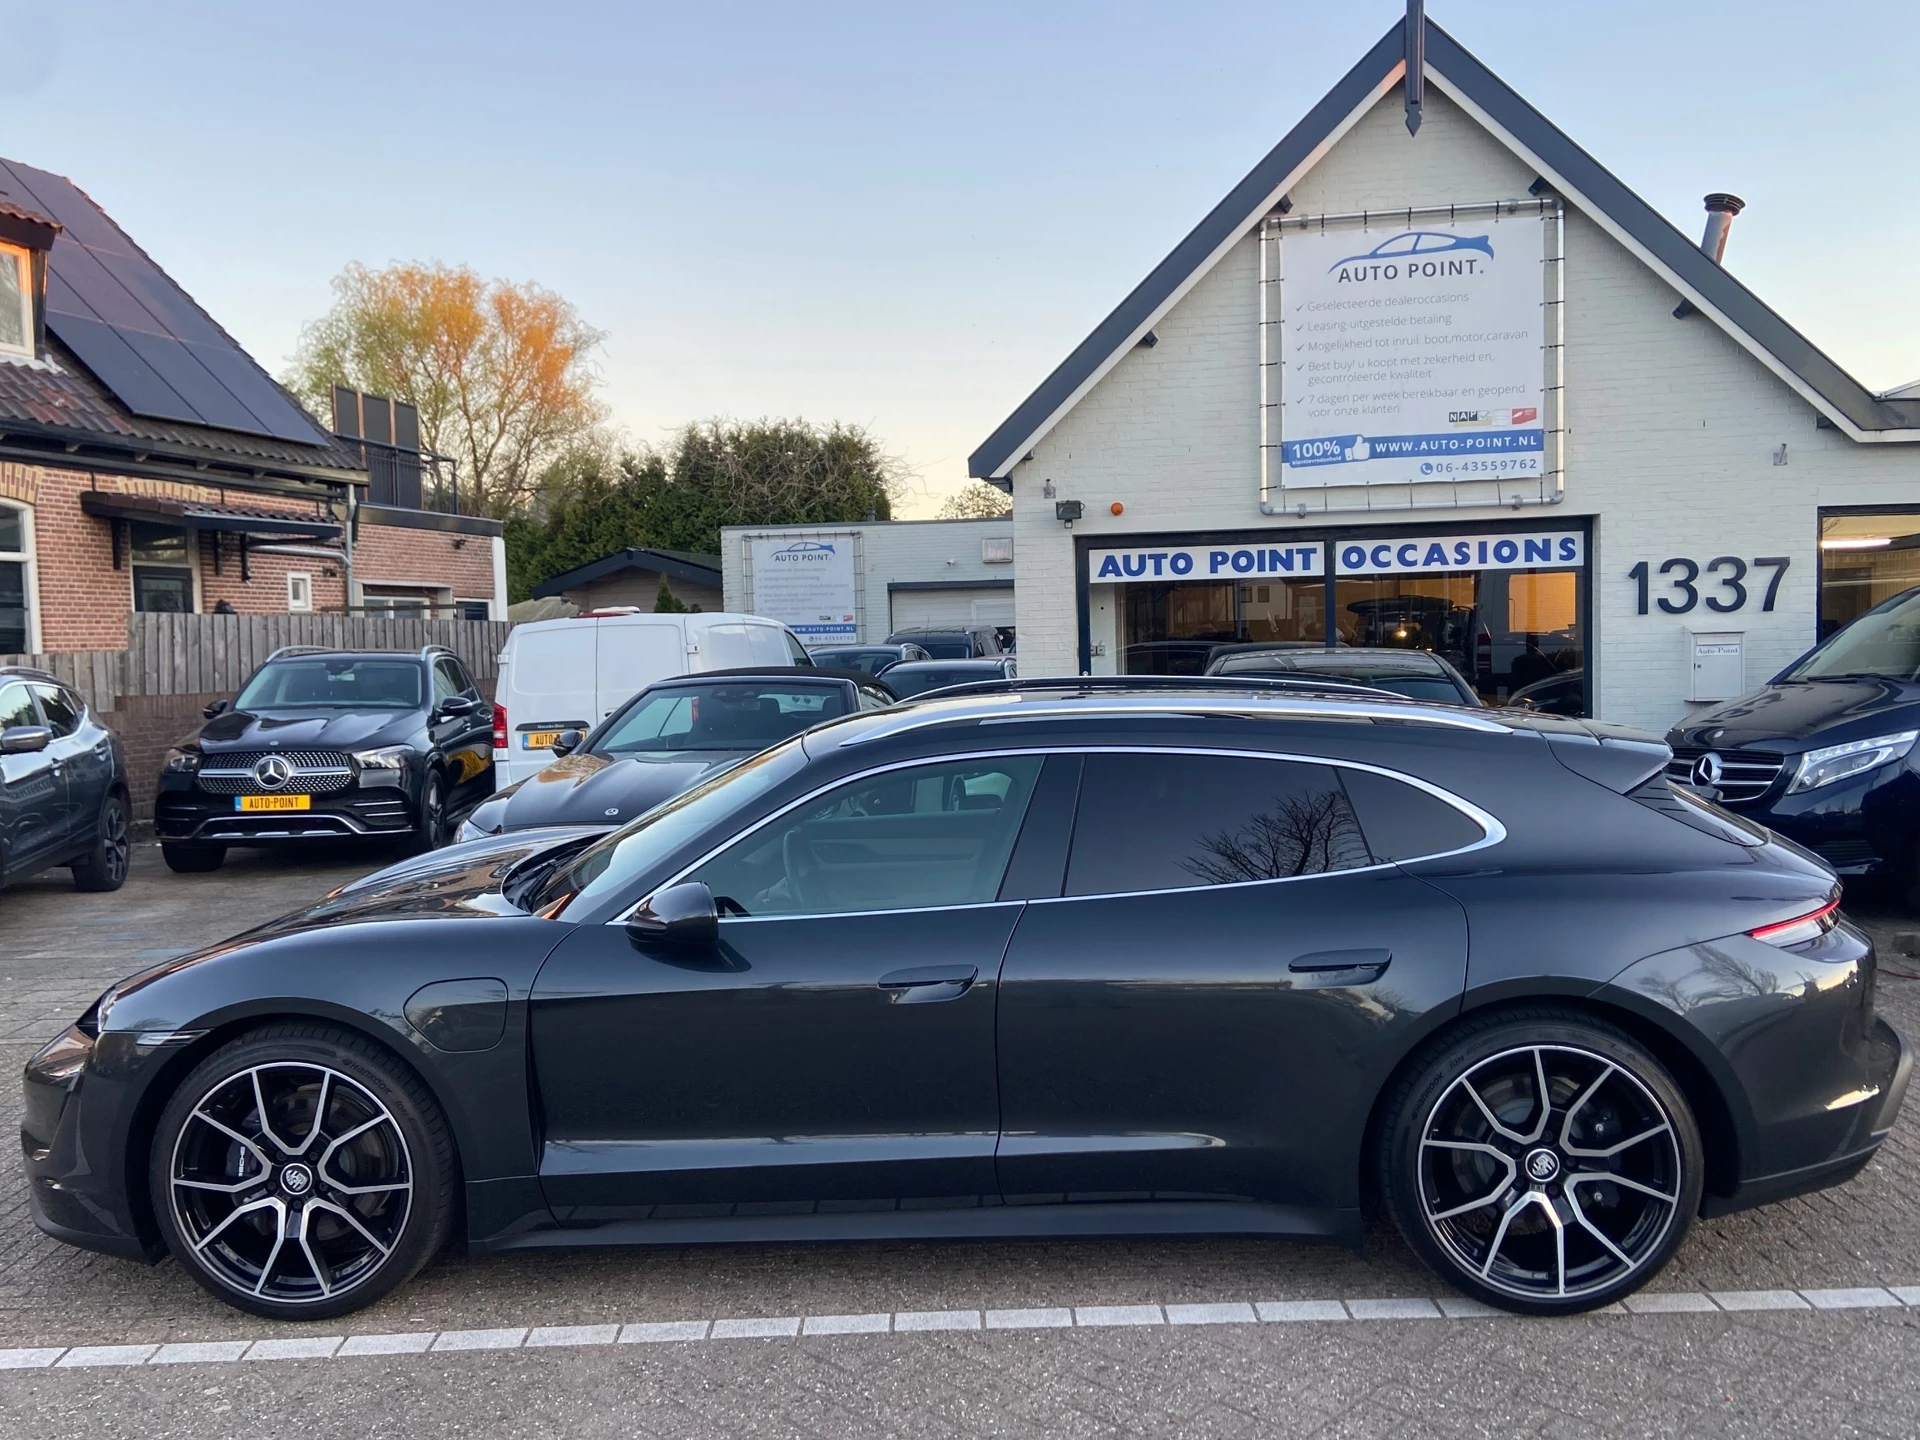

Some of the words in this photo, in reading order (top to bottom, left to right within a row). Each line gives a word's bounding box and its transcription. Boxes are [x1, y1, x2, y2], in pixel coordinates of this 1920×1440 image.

[1338, 264, 1398, 284] AUTO
[1307, 298, 1381, 312] Geselecteerde
[1384, 293, 1469, 306] dealeroccasions
[1409, 314, 1452, 326] betaling
[1308, 338, 1372, 353] Mogelijkheid
[1375, 338, 1390, 348] tot
[1308, 360, 1331, 372] Best
[1334, 359, 1355, 372] buy!
[1358, 360, 1365, 369] u
[1367, 358, 1397, 370] koopt
[1400, 356, 1420, 366] met
[1424, 352, 1475, 364] zekerheid
[1308, 372, 1387, 387] gecontroleerde
[1390, 369, 1431, 380] kwaliteit
[1308, 394, 1315, 404] 7
[1317, 393, 1350, 405] dagen
[1352, 393, 1370, 404] per
[1372, 390, 1399, 401] week
[1402, 387, 1458, 399] bereikbaar
[1461, 386, 1475, 396] en
[1478, 384, 1526, 398] geopend
[1308, 408, 1331, 418] voor
[1334, 406, 1359, 416] onze
[1362, 404, 1400, 414] klanten
[1449, 411, 1477, 422] NAP
[1292, 440, 1341, 459] 100%
[1375, 435, 1537, 453] WWW.AUTO-POINT.NL
[1436, 458, 1537, 473] 06-43559762
[1098, 552, 1194, 578] AUTO
[1209, 547, 1317, 574] POINT
[1342, 537, 1576, 569] OCCASIONS
[1628, 556, 1790, 615] 1337
[249, 797, 300, 809] AUTO-POINT
